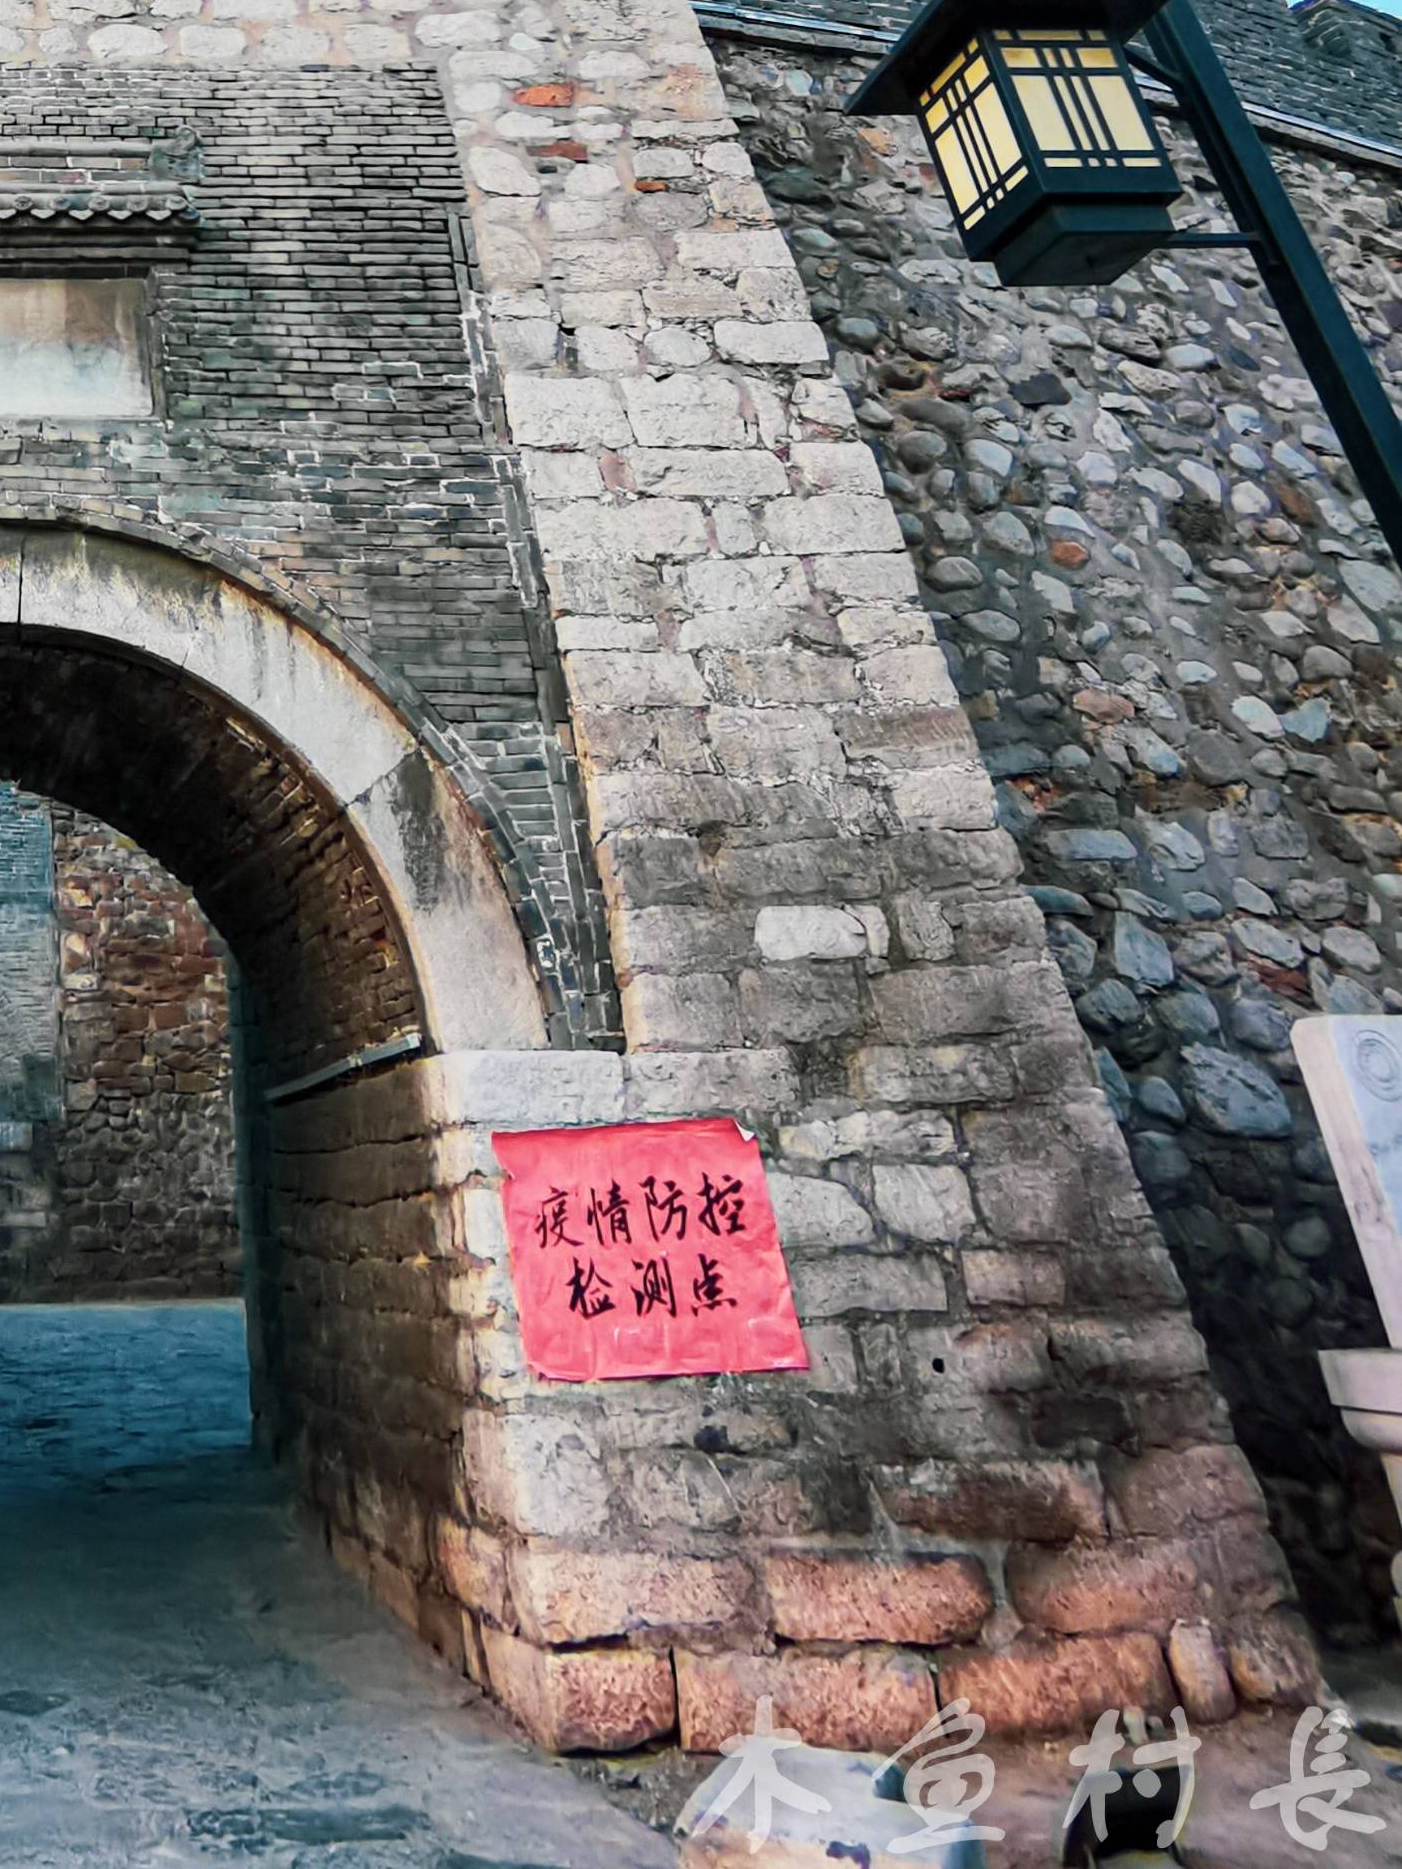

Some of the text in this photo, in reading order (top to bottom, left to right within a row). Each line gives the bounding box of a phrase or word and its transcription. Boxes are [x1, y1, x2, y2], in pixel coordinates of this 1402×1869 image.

[535, 1172, 747, 1248] 疫情防控
[566, 1254, 738, 1320] 检测点
